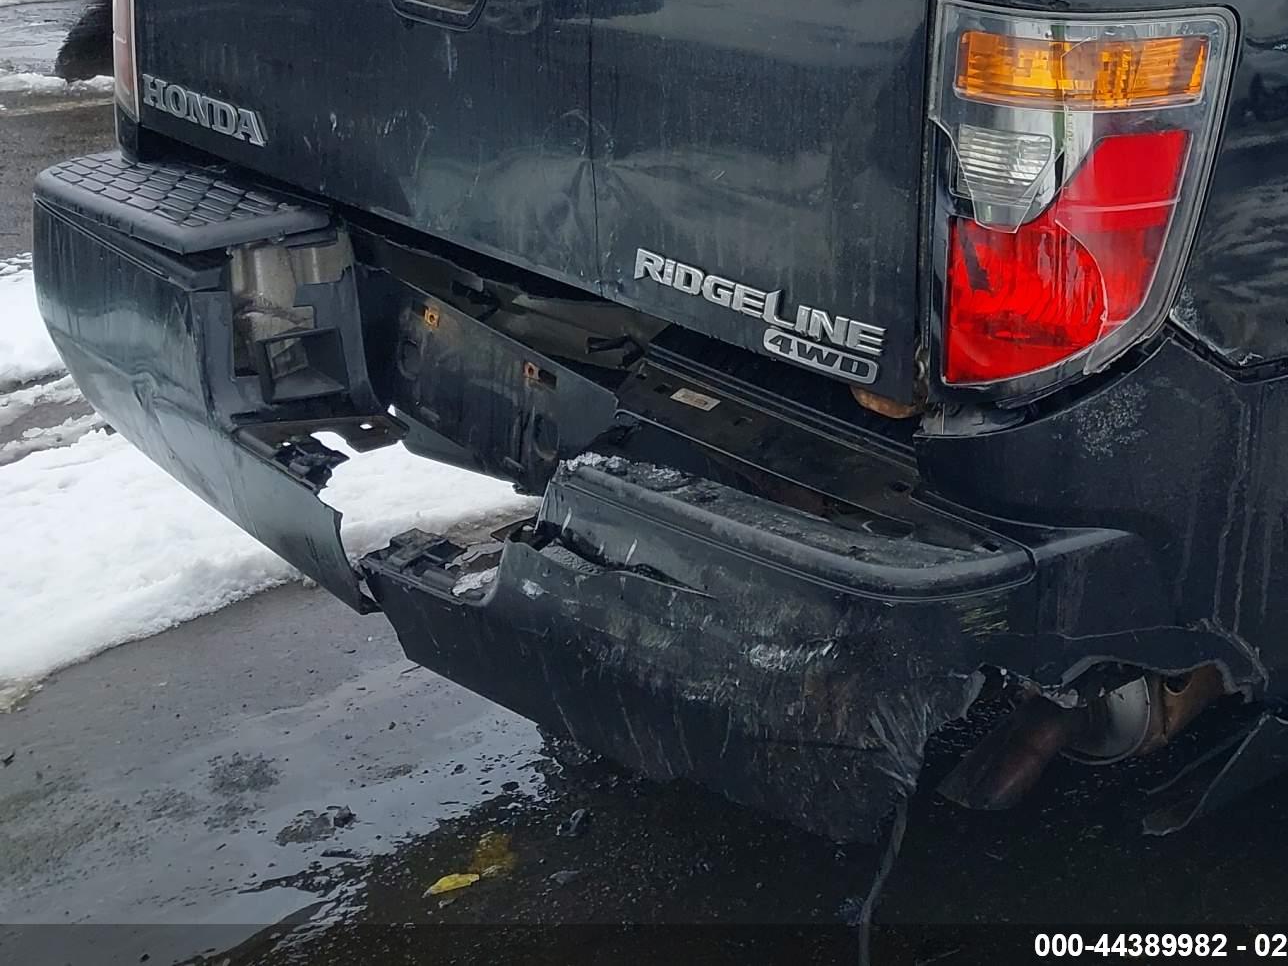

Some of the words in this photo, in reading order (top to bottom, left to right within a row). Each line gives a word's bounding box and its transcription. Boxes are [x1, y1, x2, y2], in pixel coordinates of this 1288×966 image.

[142, 73, 267, 147] HONDA
[633, 247, 887, 357] RIDGELINE
[767, 333, 871, 379] 4WD
